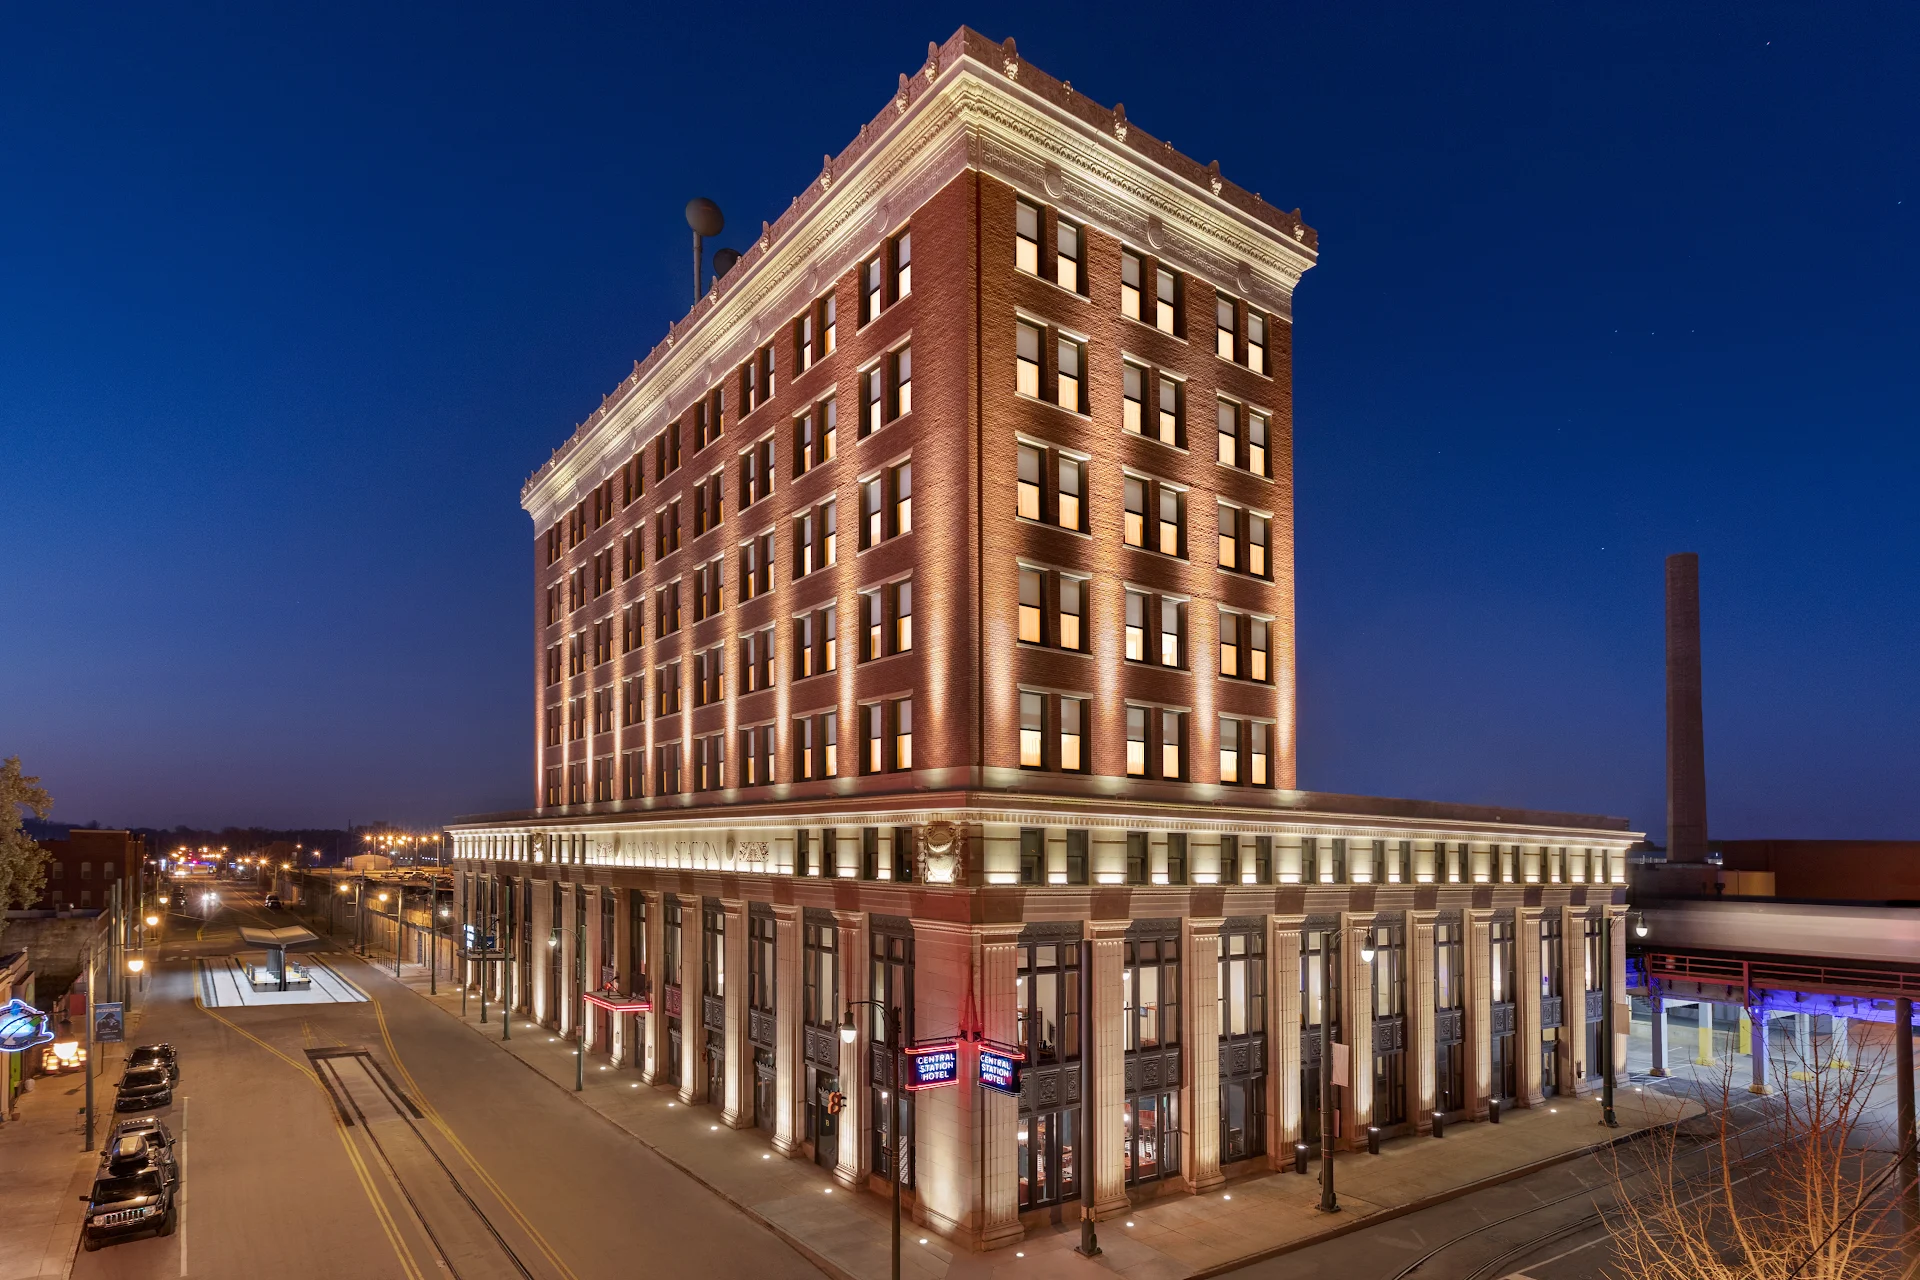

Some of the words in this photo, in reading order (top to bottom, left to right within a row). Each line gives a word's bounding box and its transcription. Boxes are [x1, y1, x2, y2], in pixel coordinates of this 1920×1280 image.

[625, 840, 667, 859] CENTRAL
[674, 841, 719, 861] STATION
[917, 1053, 955, 1065] CENTRAL
[980, 1054, 1011, 1070] CENTRAL
[920, 1061, 954, 1073] STATION
[981, 1063, 1011, 1078] STATION
[921, 1070, 949, 1081] HOTEL
[983, 1072, 1006, 1085] HOTEL
